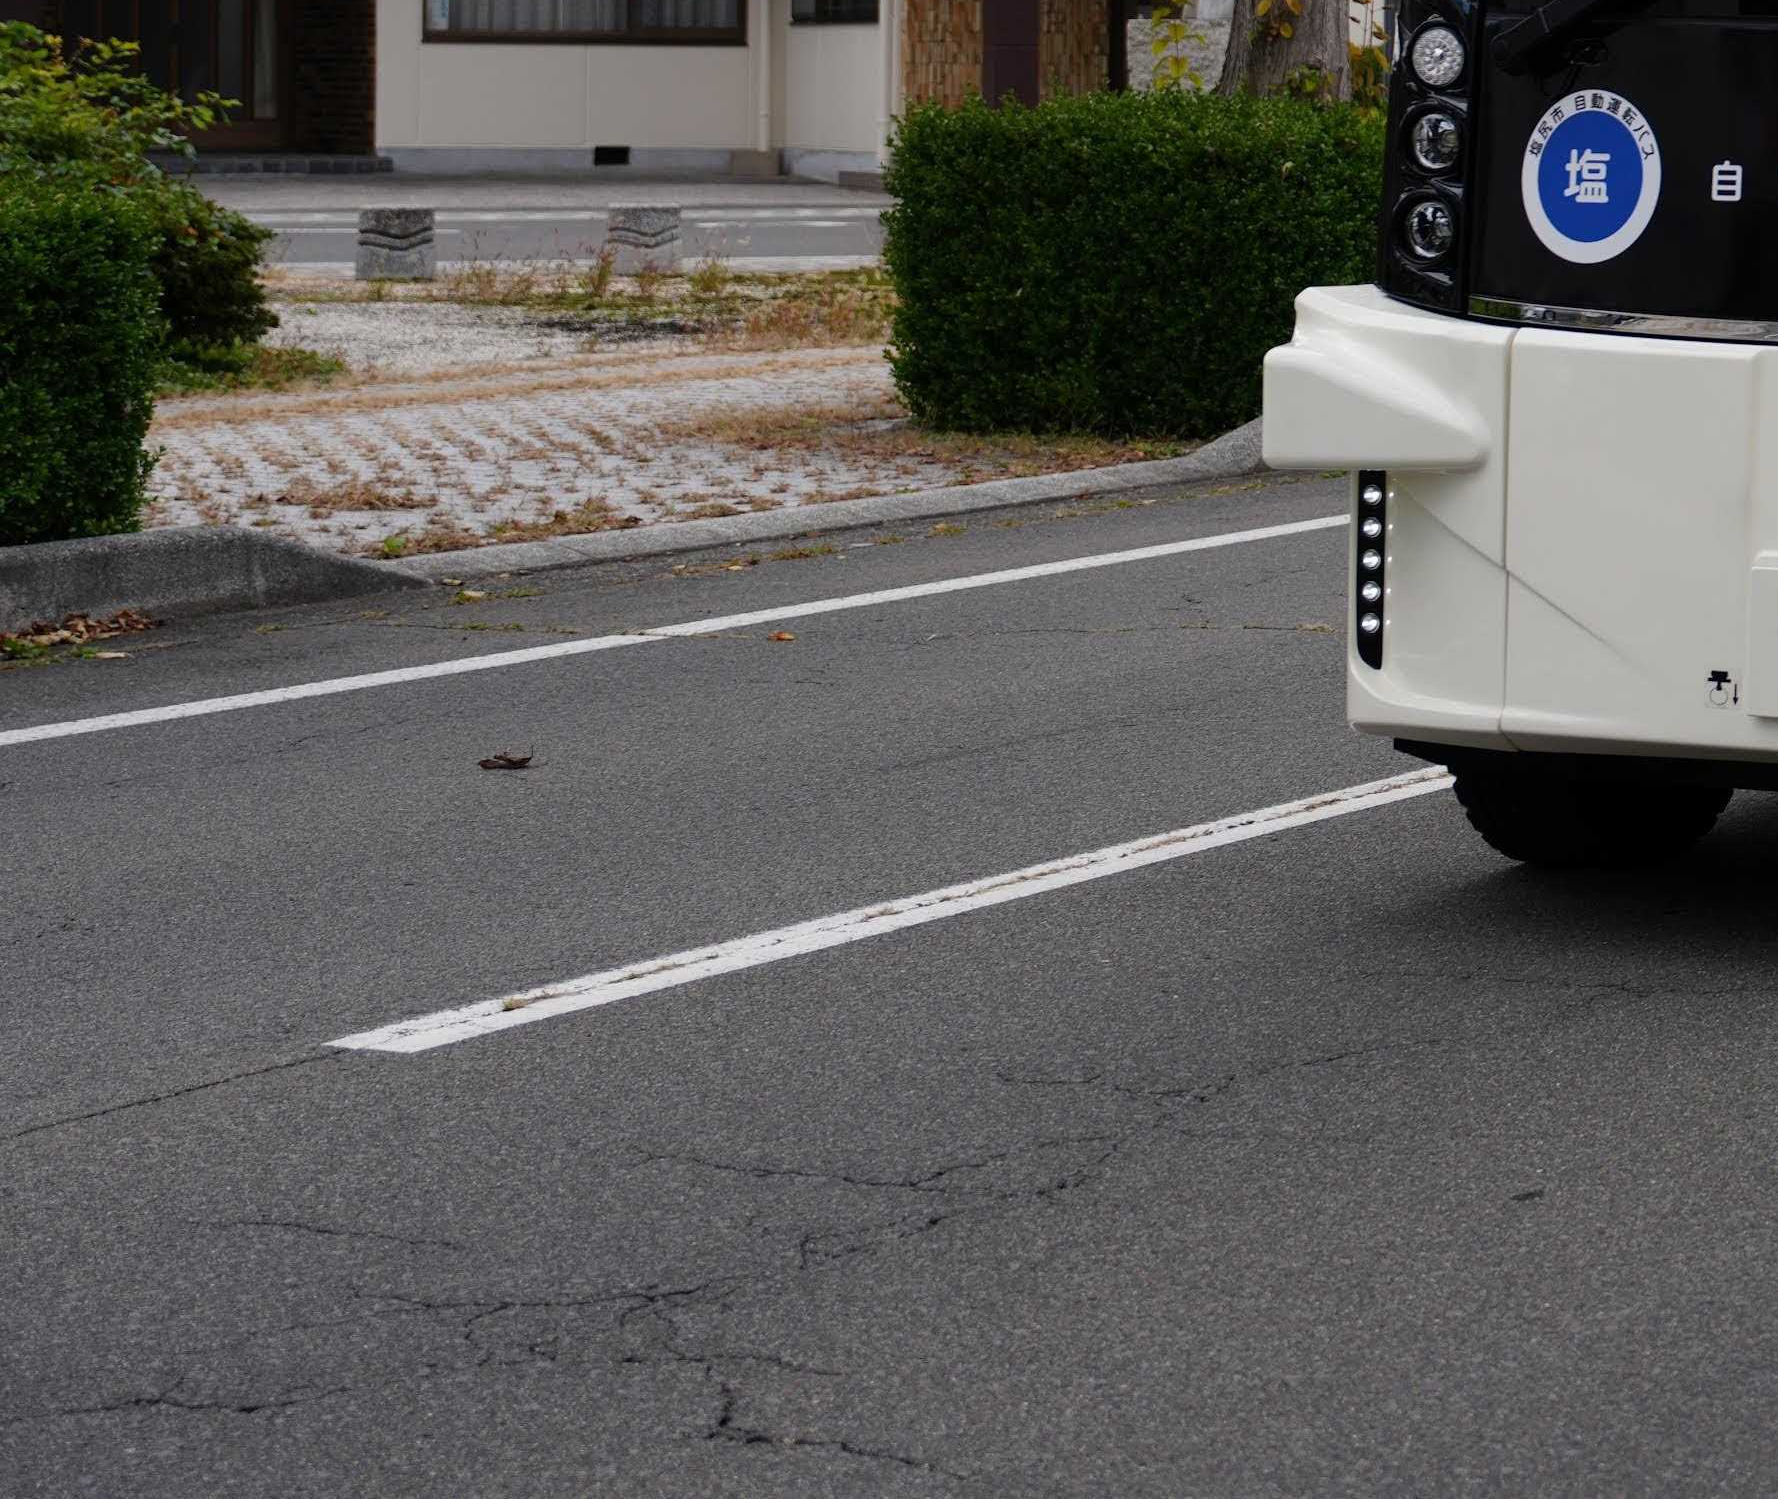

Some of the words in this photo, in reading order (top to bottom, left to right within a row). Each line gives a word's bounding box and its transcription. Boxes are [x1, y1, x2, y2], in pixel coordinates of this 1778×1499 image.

[1528, 106, 1565, 158] 塩尻市
[1574, 93, 1655, 160] 自動運転バス
[1563, 148, 1611, 203] 塩
